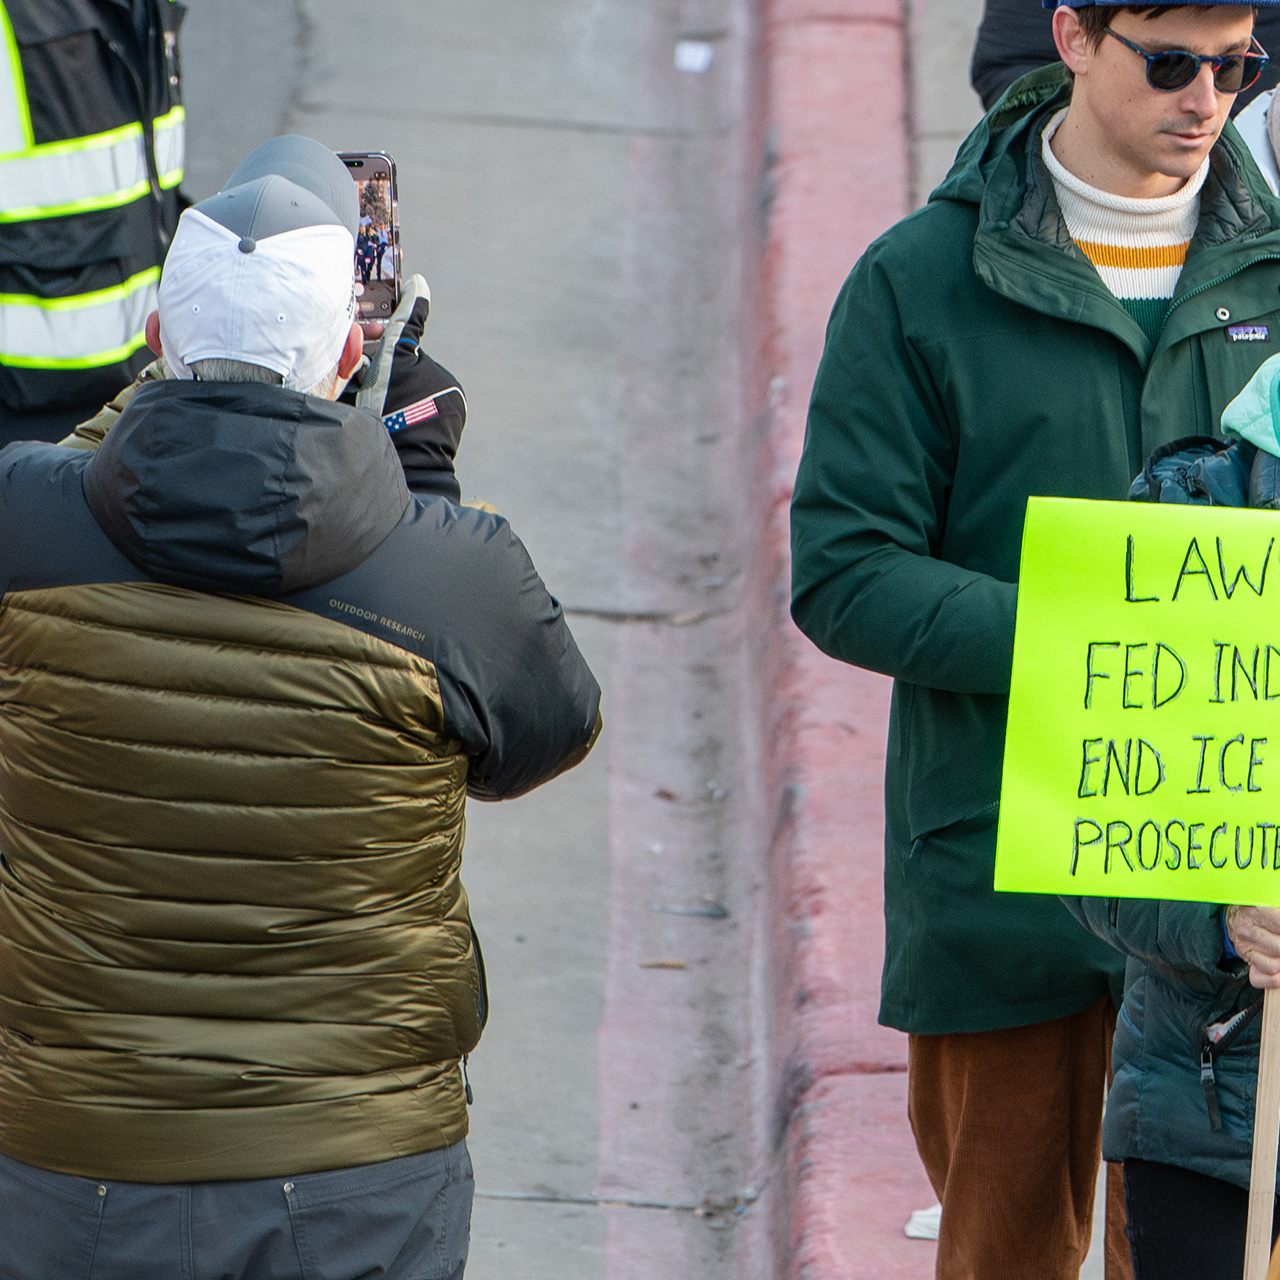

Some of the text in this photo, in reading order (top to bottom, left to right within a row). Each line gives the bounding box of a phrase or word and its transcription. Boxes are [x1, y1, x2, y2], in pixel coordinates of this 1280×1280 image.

[329, 599, 426, 641] OUTDOOR RESEARCH
[1084, 640, 1189, 710] FED
[1078, 737, 1167, 798] END
[1186, 733, 1268, 795] ICE
